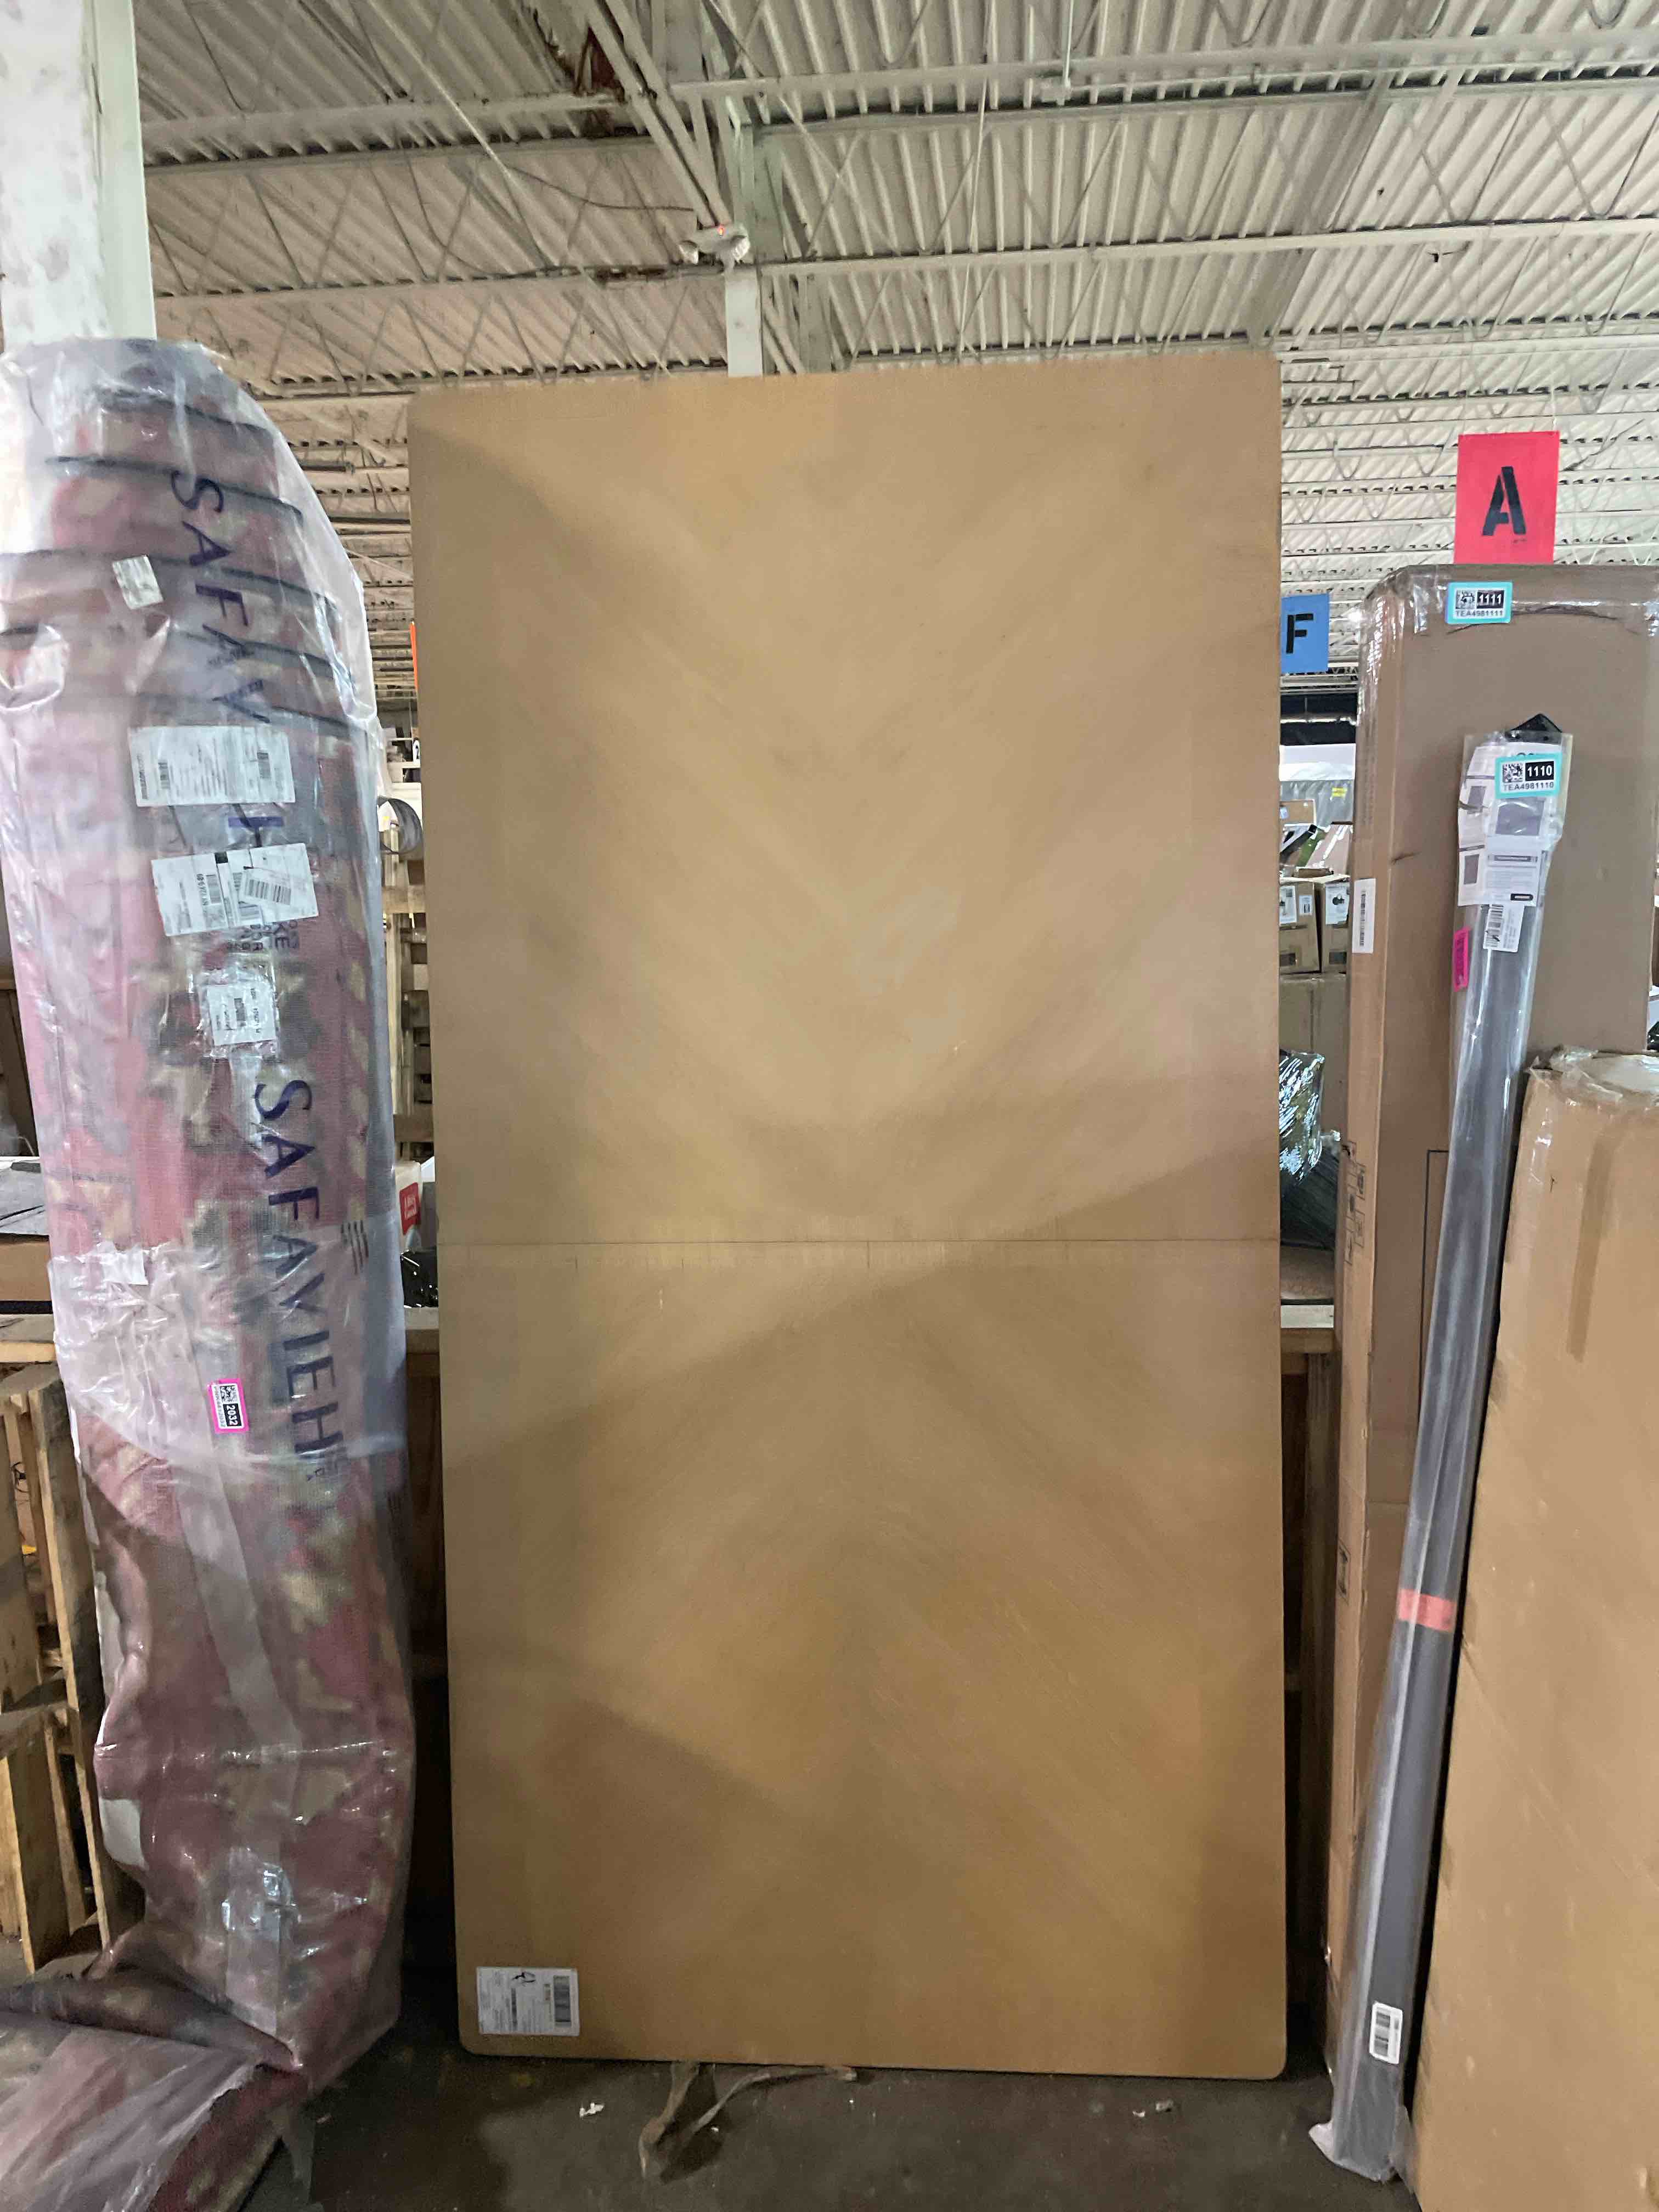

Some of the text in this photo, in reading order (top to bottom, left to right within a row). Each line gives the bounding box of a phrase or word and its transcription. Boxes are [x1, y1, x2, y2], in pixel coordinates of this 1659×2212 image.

[1482, 466, 1527, 536] A
[1479, 593, 1503, 606] 1111
[1286, 613, 1314, 654] F
[1527, 765, 1553, 777] 1110
[1503, 781, 1554, 791] TEA4981110
[255, 1079, 344, 1458] SAFAVIEH
[226, 1405, 238, 1426] 2032
